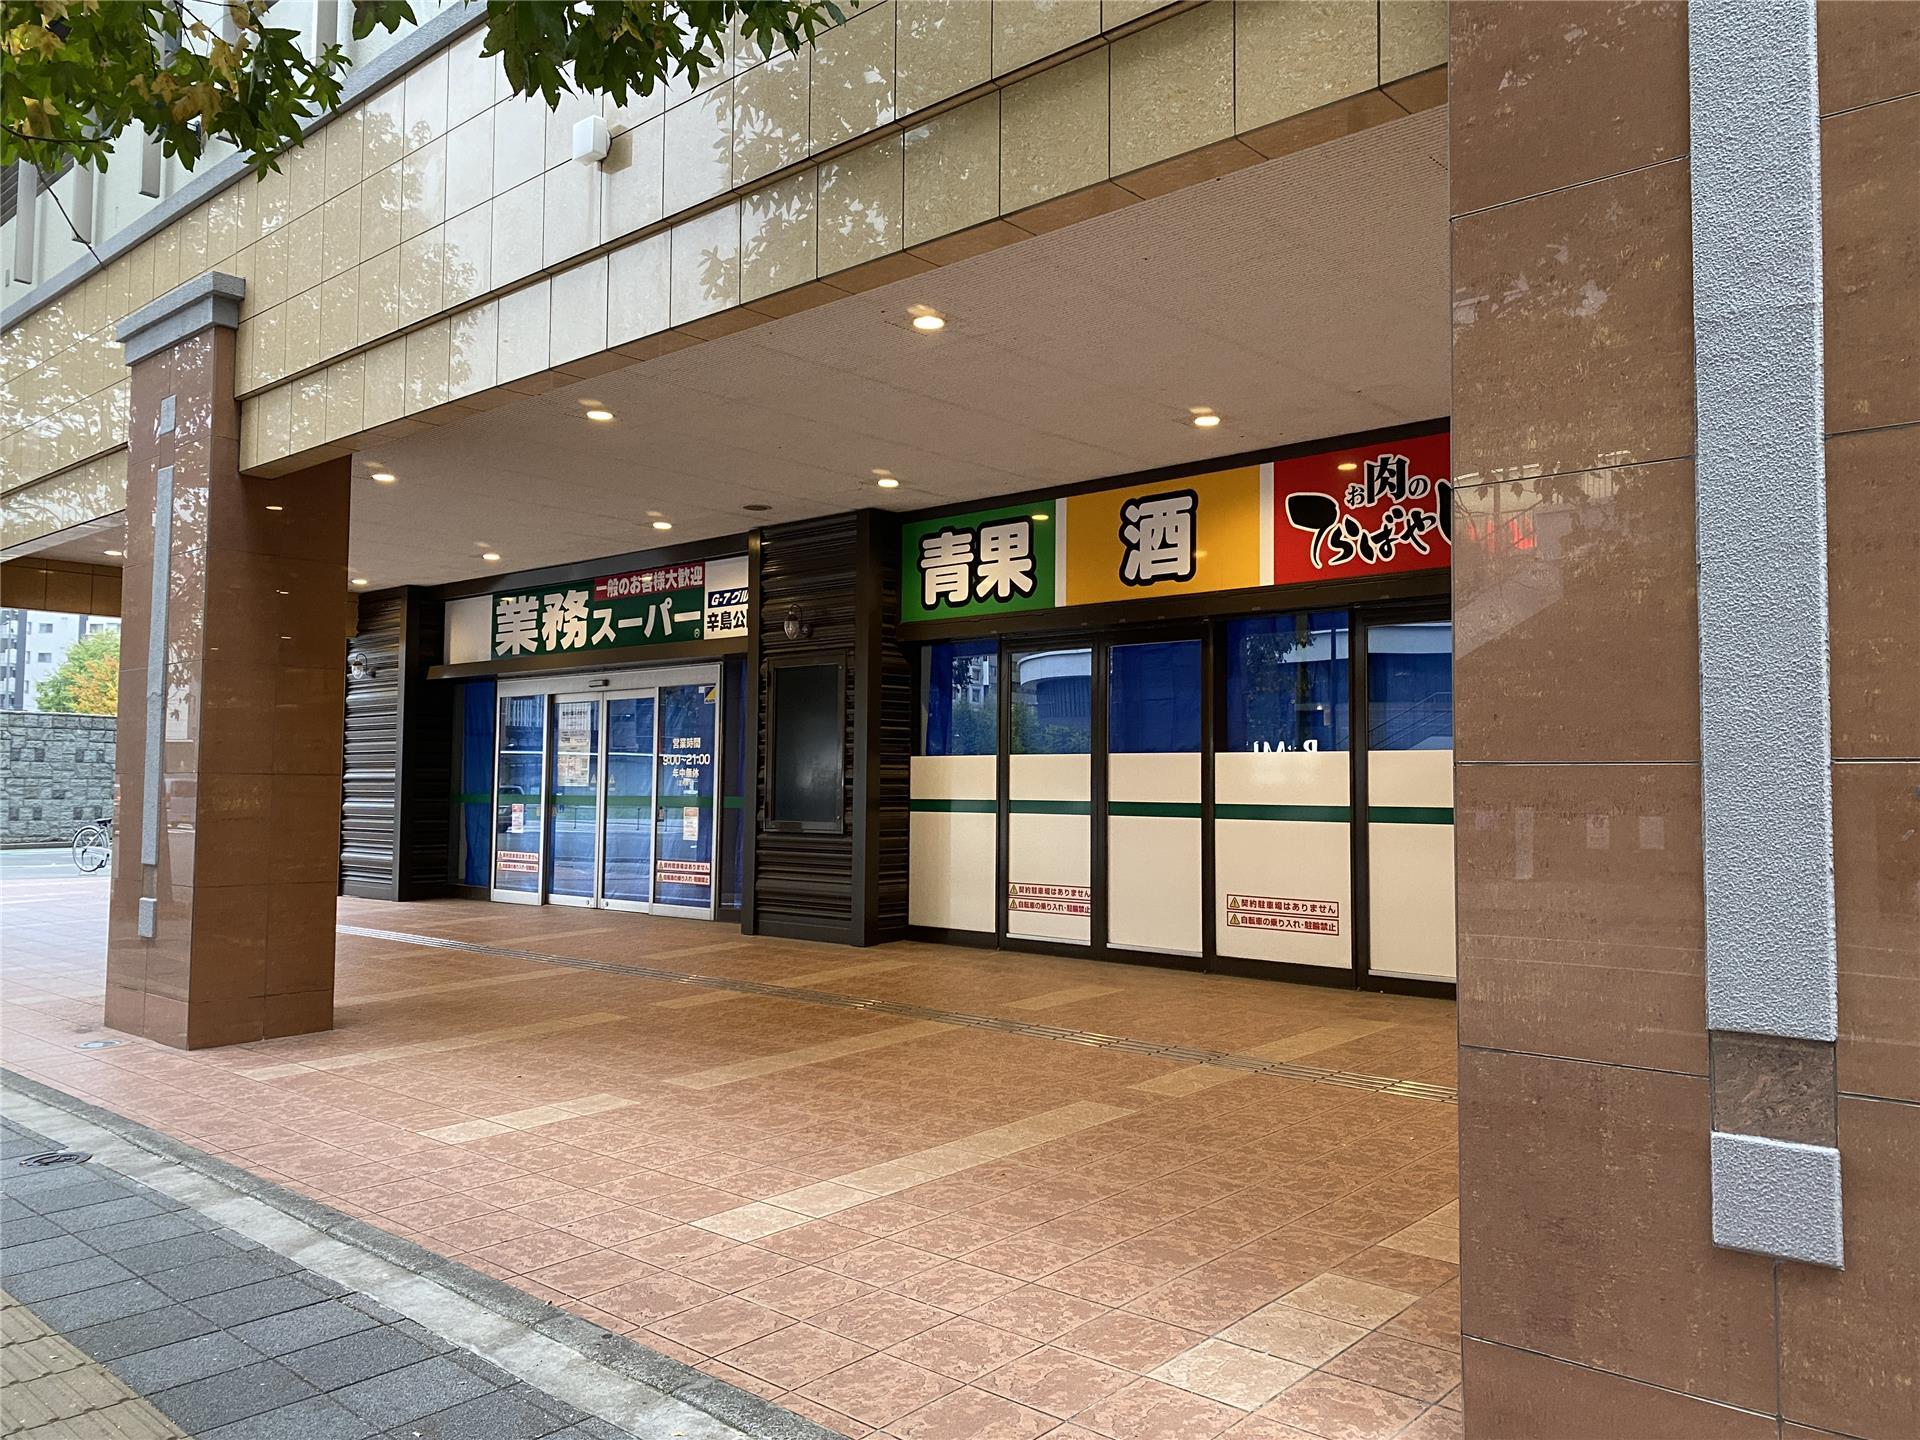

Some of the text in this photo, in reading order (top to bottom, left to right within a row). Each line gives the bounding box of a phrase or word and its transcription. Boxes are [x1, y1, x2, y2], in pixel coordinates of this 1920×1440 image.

[1345, 455, 1429, 507] お肉の
[1121, 492, 1195, 583] 酒
[595, 566, 703, 598] 一般のお客様大歓迎
[918, 519, 1035, 607] 青果
[495, 590, 701, 656] 業務スーパー
[707, 609, 748, 632] 辛島公
[671, 737, 701, 749] 営業時間
[1241, 899, 1336, 914] 契約駐車場はありません
